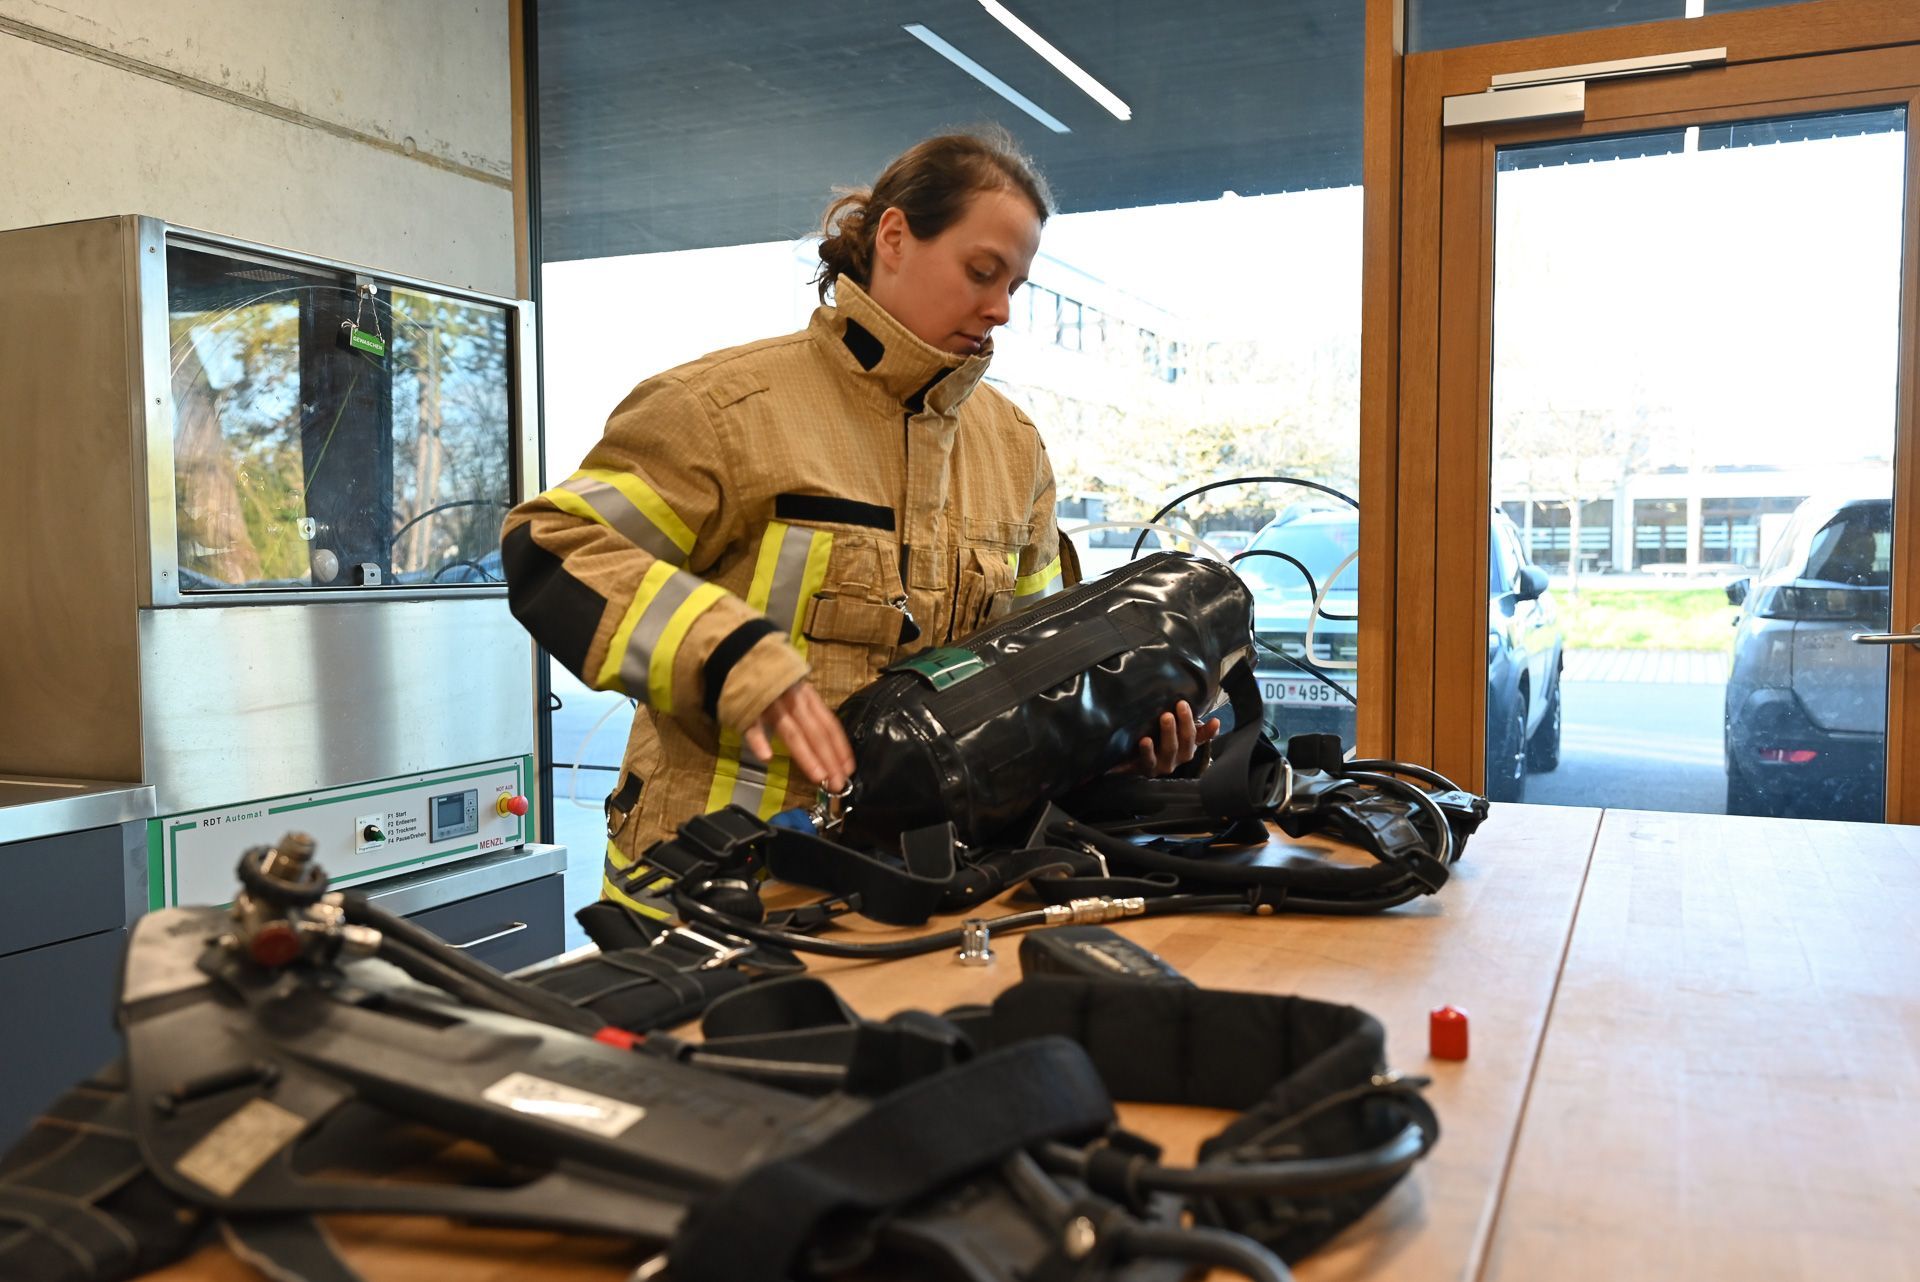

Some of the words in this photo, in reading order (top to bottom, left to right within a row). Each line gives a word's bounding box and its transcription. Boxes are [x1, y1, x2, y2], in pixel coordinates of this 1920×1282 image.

[352, 335, 383, 351] GEWASCHEN
[1298, 683, 1329, 701] 495
[203, 816, 221, 827] RDT
[225, 810, 262, 823] Automat
[395, 832, 427, 842] Pause/Drehen
[396, 826, 417, 834] Trocknen
[480, 837, 504, 850] MENZL
